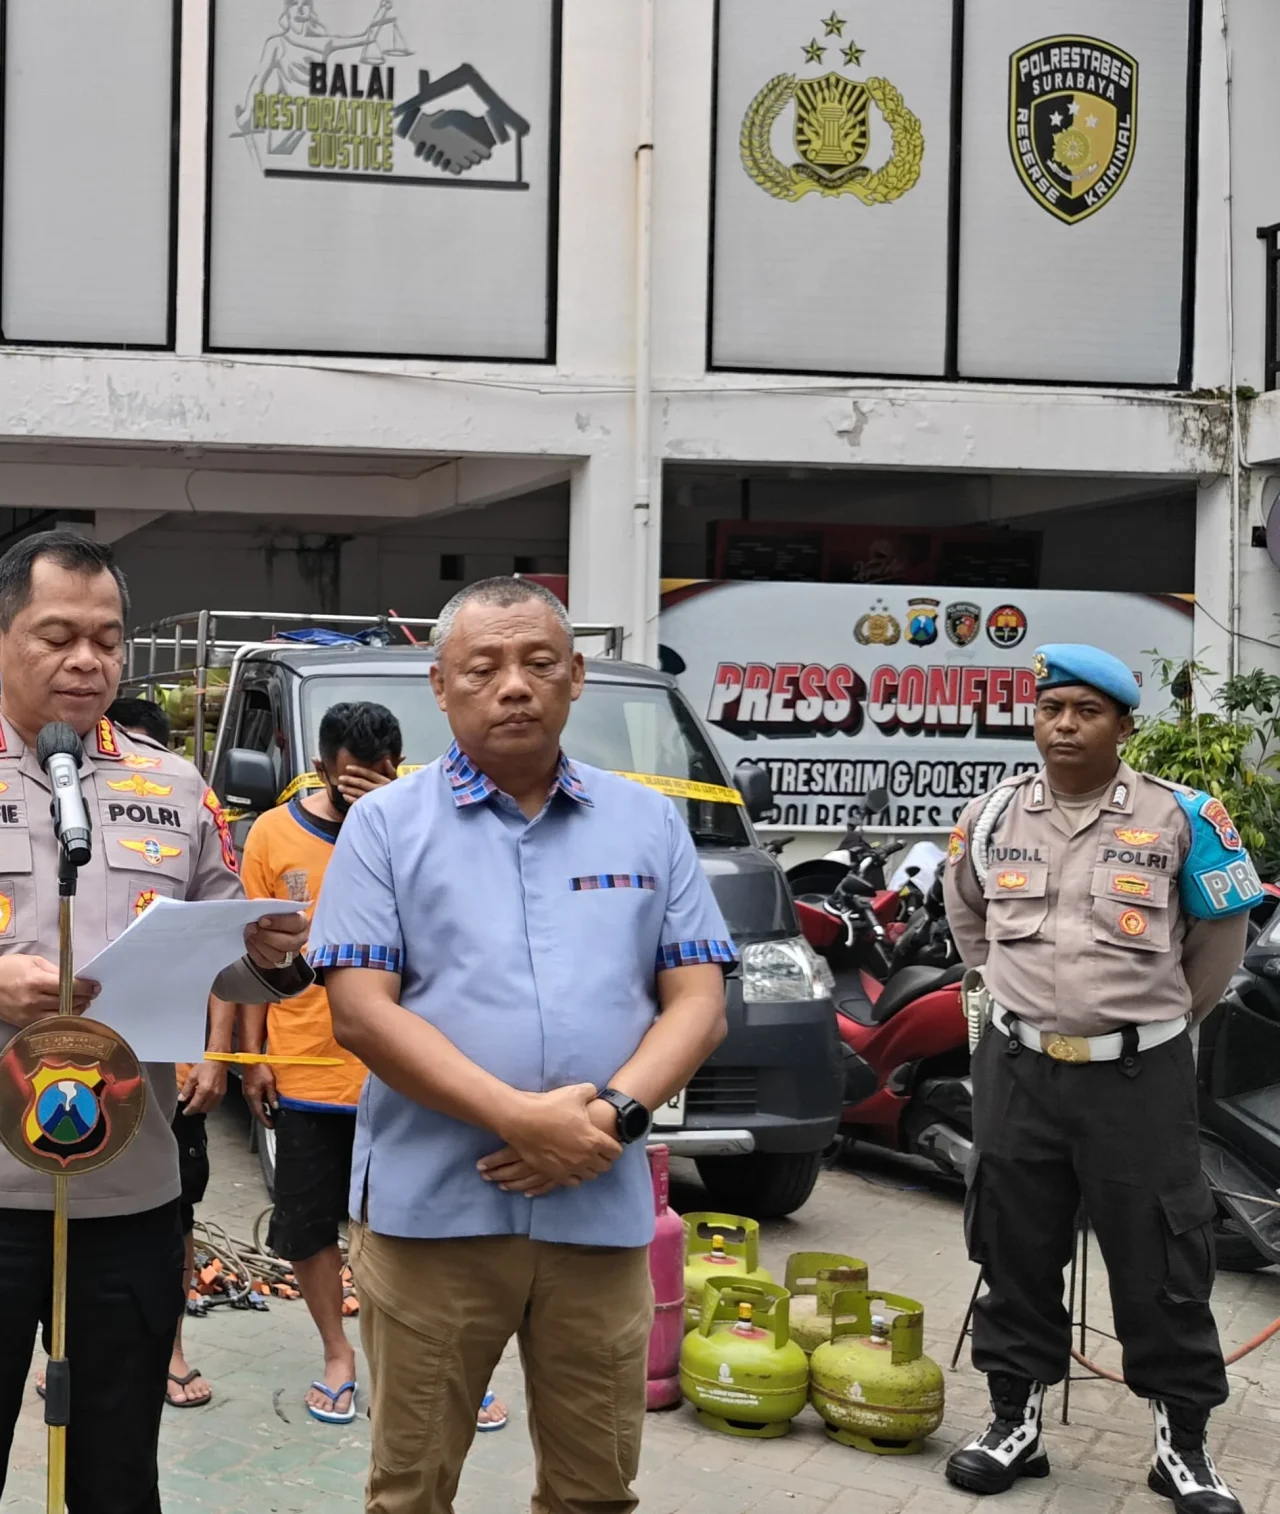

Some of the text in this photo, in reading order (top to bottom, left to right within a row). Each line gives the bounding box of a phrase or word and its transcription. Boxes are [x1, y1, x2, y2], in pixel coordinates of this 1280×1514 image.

[309, 61, 395, 100] BALAI
[1019, 47, 1132, 88] POLRESTABES
[1032, 72, 1116, 100] SURABAYA
[253, 93, 394, 138] RESTORATIVE
[307, 133, 394, 172] JUSTICE
[1017, 107, 1061, 204] RESERSE
[1083, 113, 1131, 206] KRIMINAL
[706, 661, 1038, 738] PRESS CONFER
[738, 758, 1005, 797] TRESKRIM & POLSEK
[110, 803, 180, 828] POLRI
[992, 848, 1042, 861] UDI.L
[1104, 848, 1168, 869] POLRI
